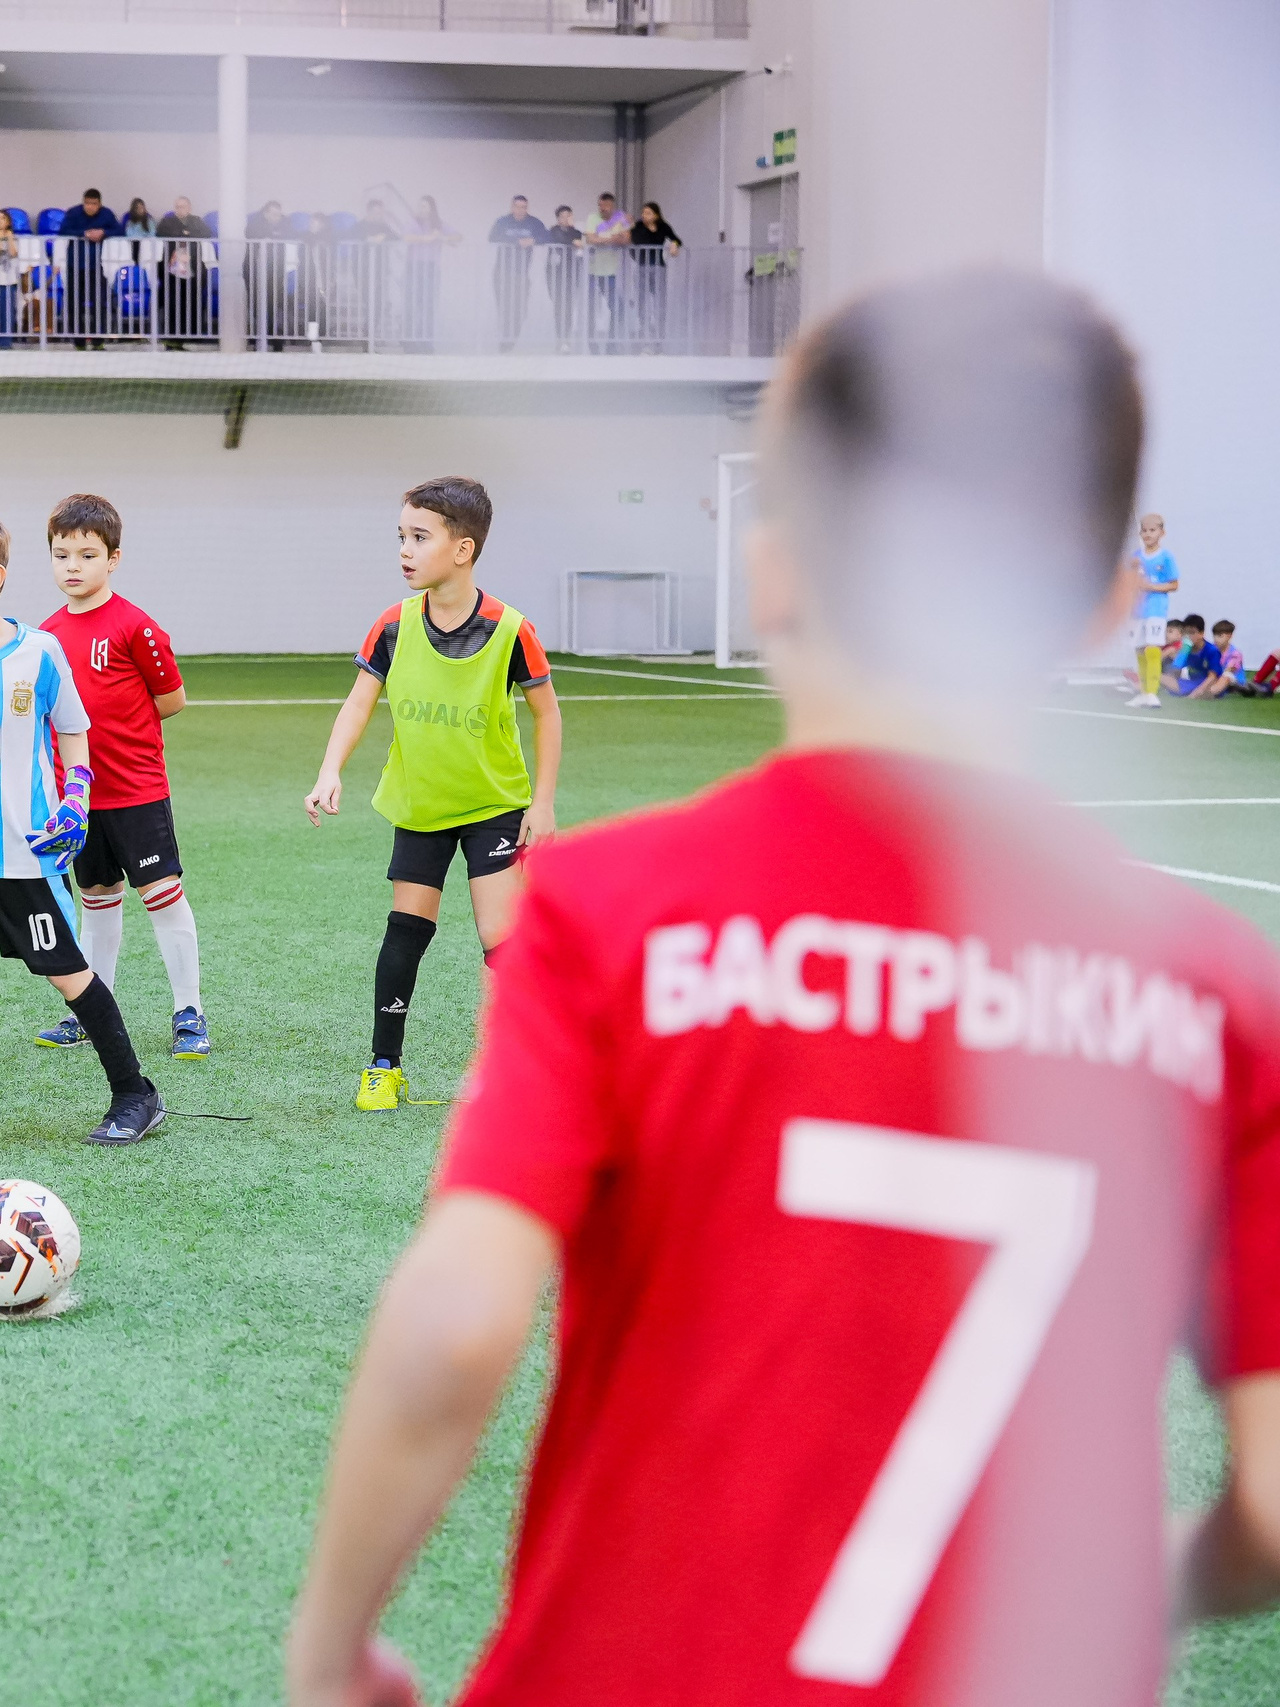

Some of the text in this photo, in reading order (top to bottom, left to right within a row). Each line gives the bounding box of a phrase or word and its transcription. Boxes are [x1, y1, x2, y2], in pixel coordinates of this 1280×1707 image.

[139, 854, 160, 868] JAKO
[28, 913, 57, 951] 10
[642, 912, 1224, 1102] БАСТРЫКИН
[777, 1115, 1098, 1688] 7
